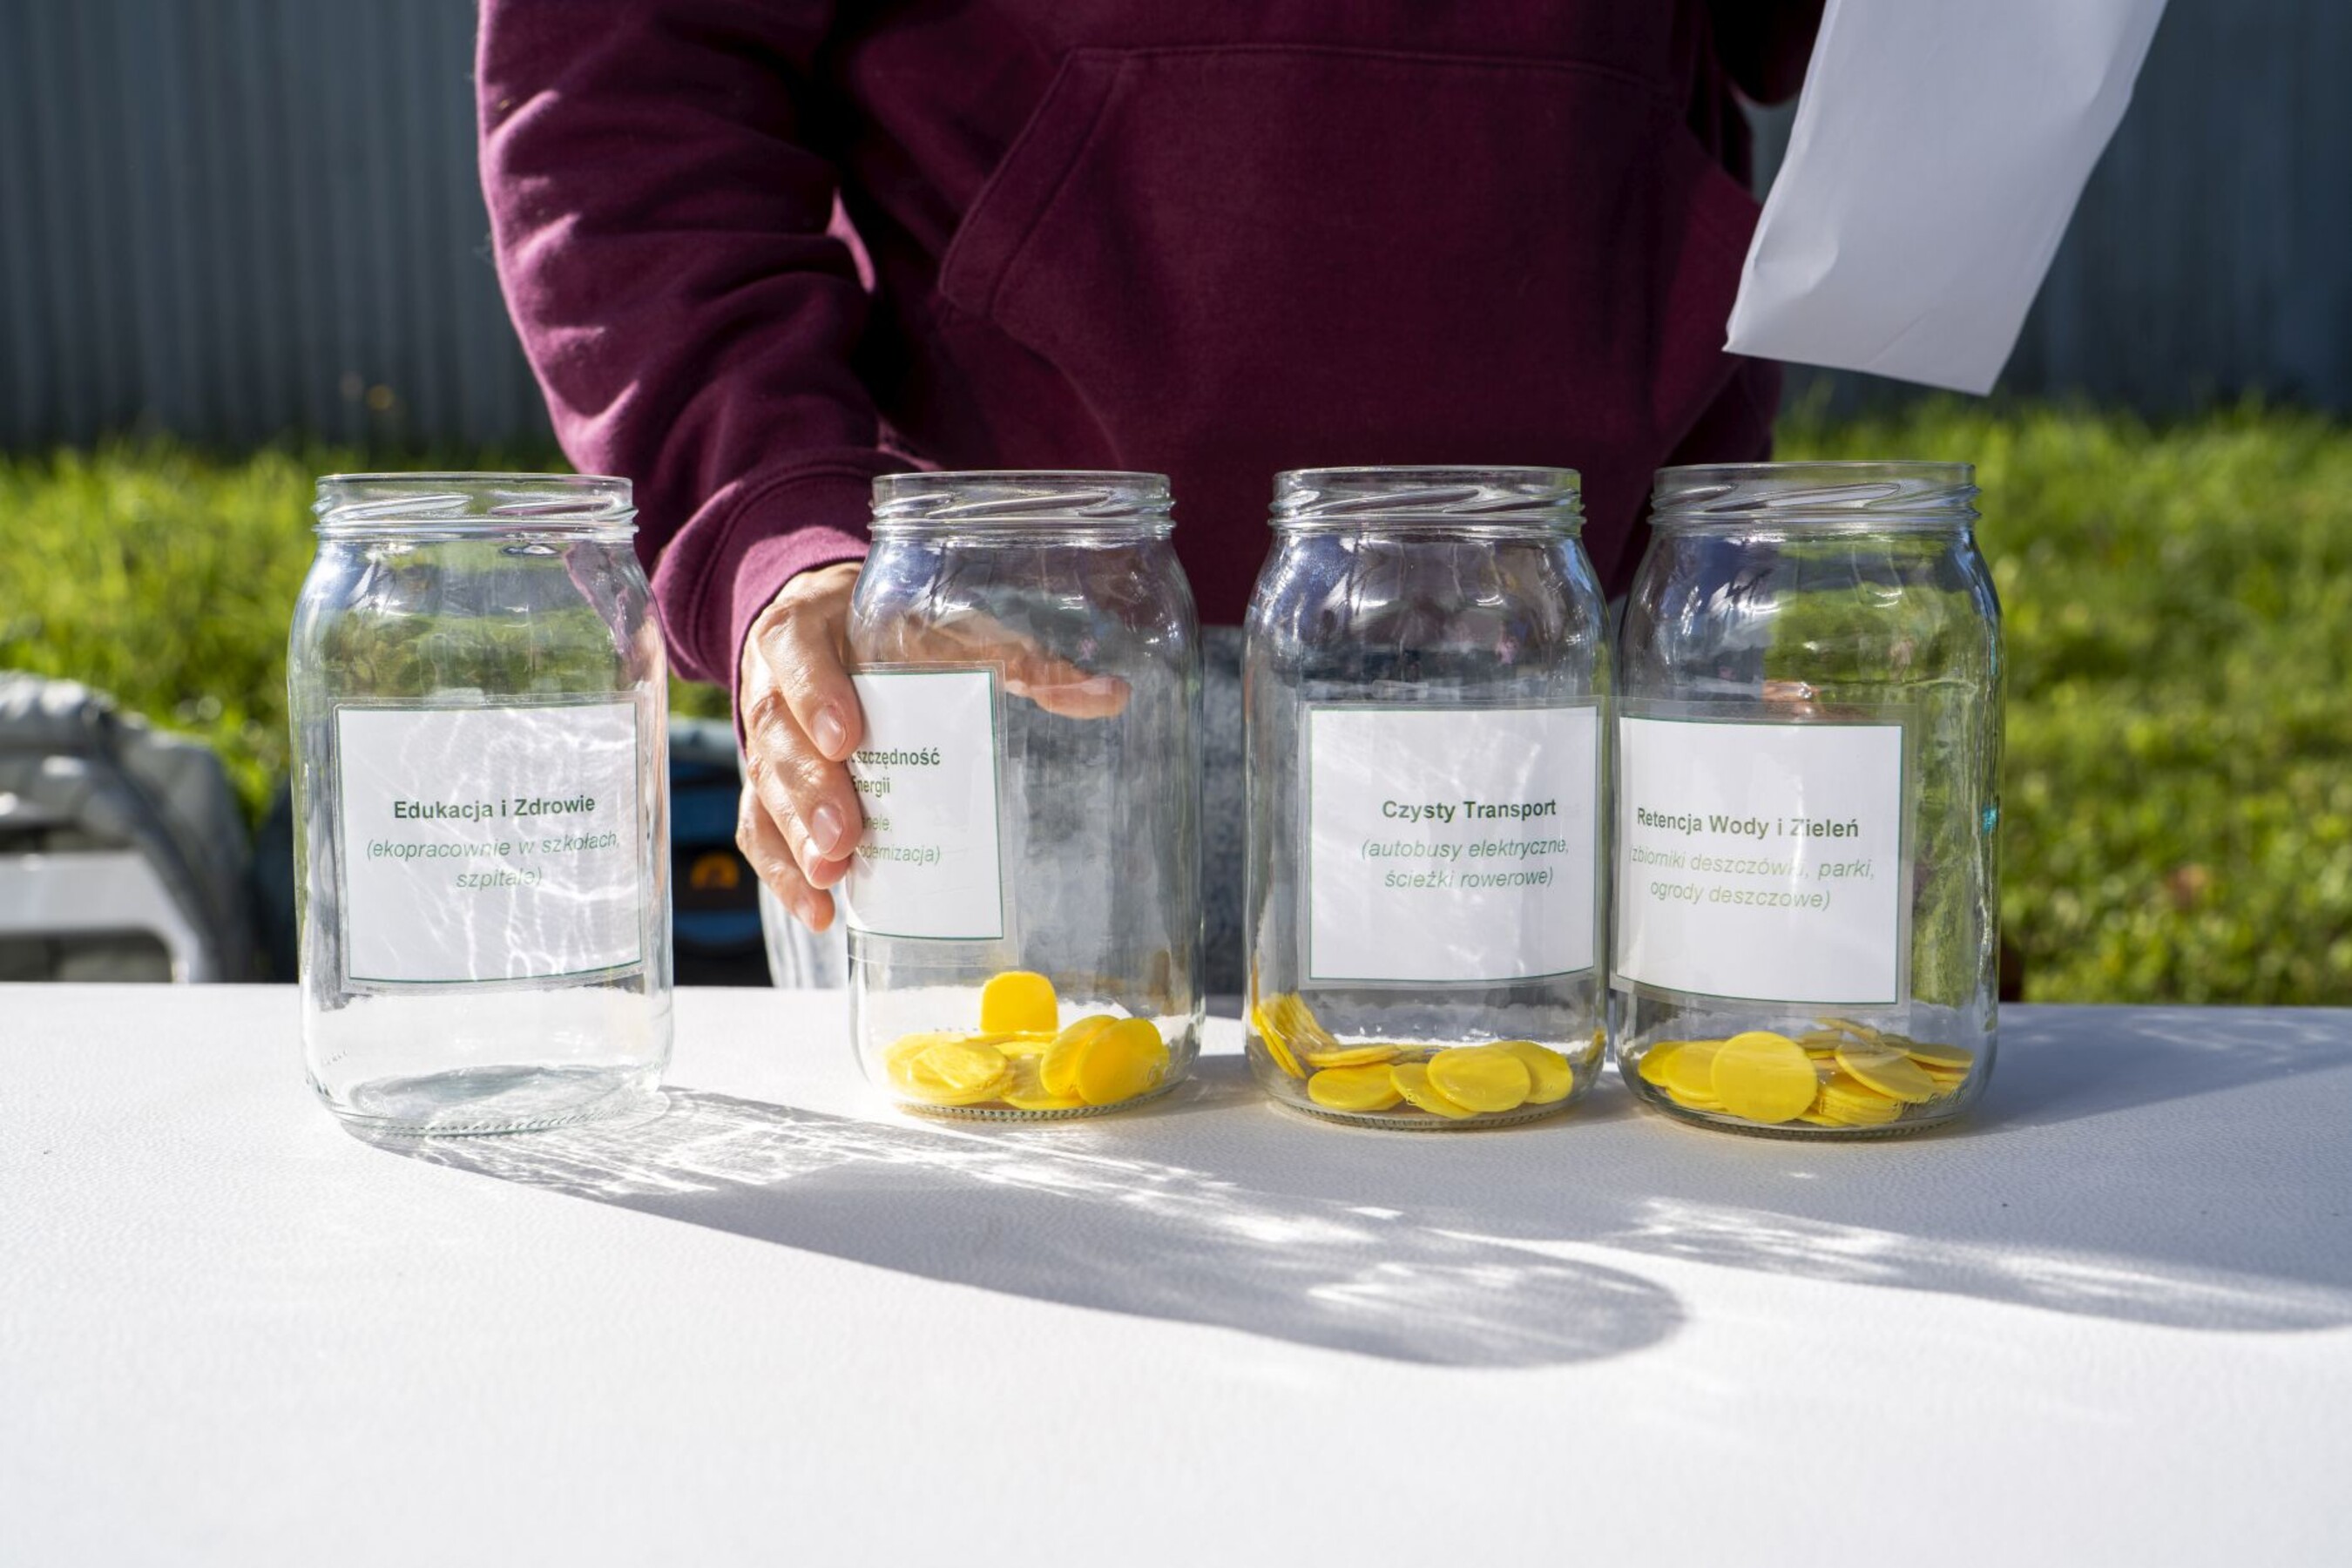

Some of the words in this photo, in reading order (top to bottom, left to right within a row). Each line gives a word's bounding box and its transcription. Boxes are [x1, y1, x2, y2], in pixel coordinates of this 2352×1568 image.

[393, 801, 493, 822] Edukacja
[501, 800, 507, 817] i
[513, 794, 596, 817] Zdrowie
[1382, 801, 1456, 823] Czysty
[1463, 799, 1557, 821] Transport
[1637, 808, 1702, 835] Retencja
[1708, 815, 1769, 840] Wody
[1777, 818, 1782, 836] i
[1789, 818, 1859, 838] Zieleń
[366, 839, 510, 862] (ekopracownie
[518, 841, 534, 855] w
[1361, 839, 1463, 862] (autobusy
[1468, 837, 1569, 860] elektryczne,
[1384, 869, 1454, 889] ścieżki
[1460, 867, 1553, 888] rowerowe)
[1817, 858, 1875, 880] parki,
[1650, 880, 1701, 903] ogrody
[1708, 885, 1831, 911] deszczowe)
